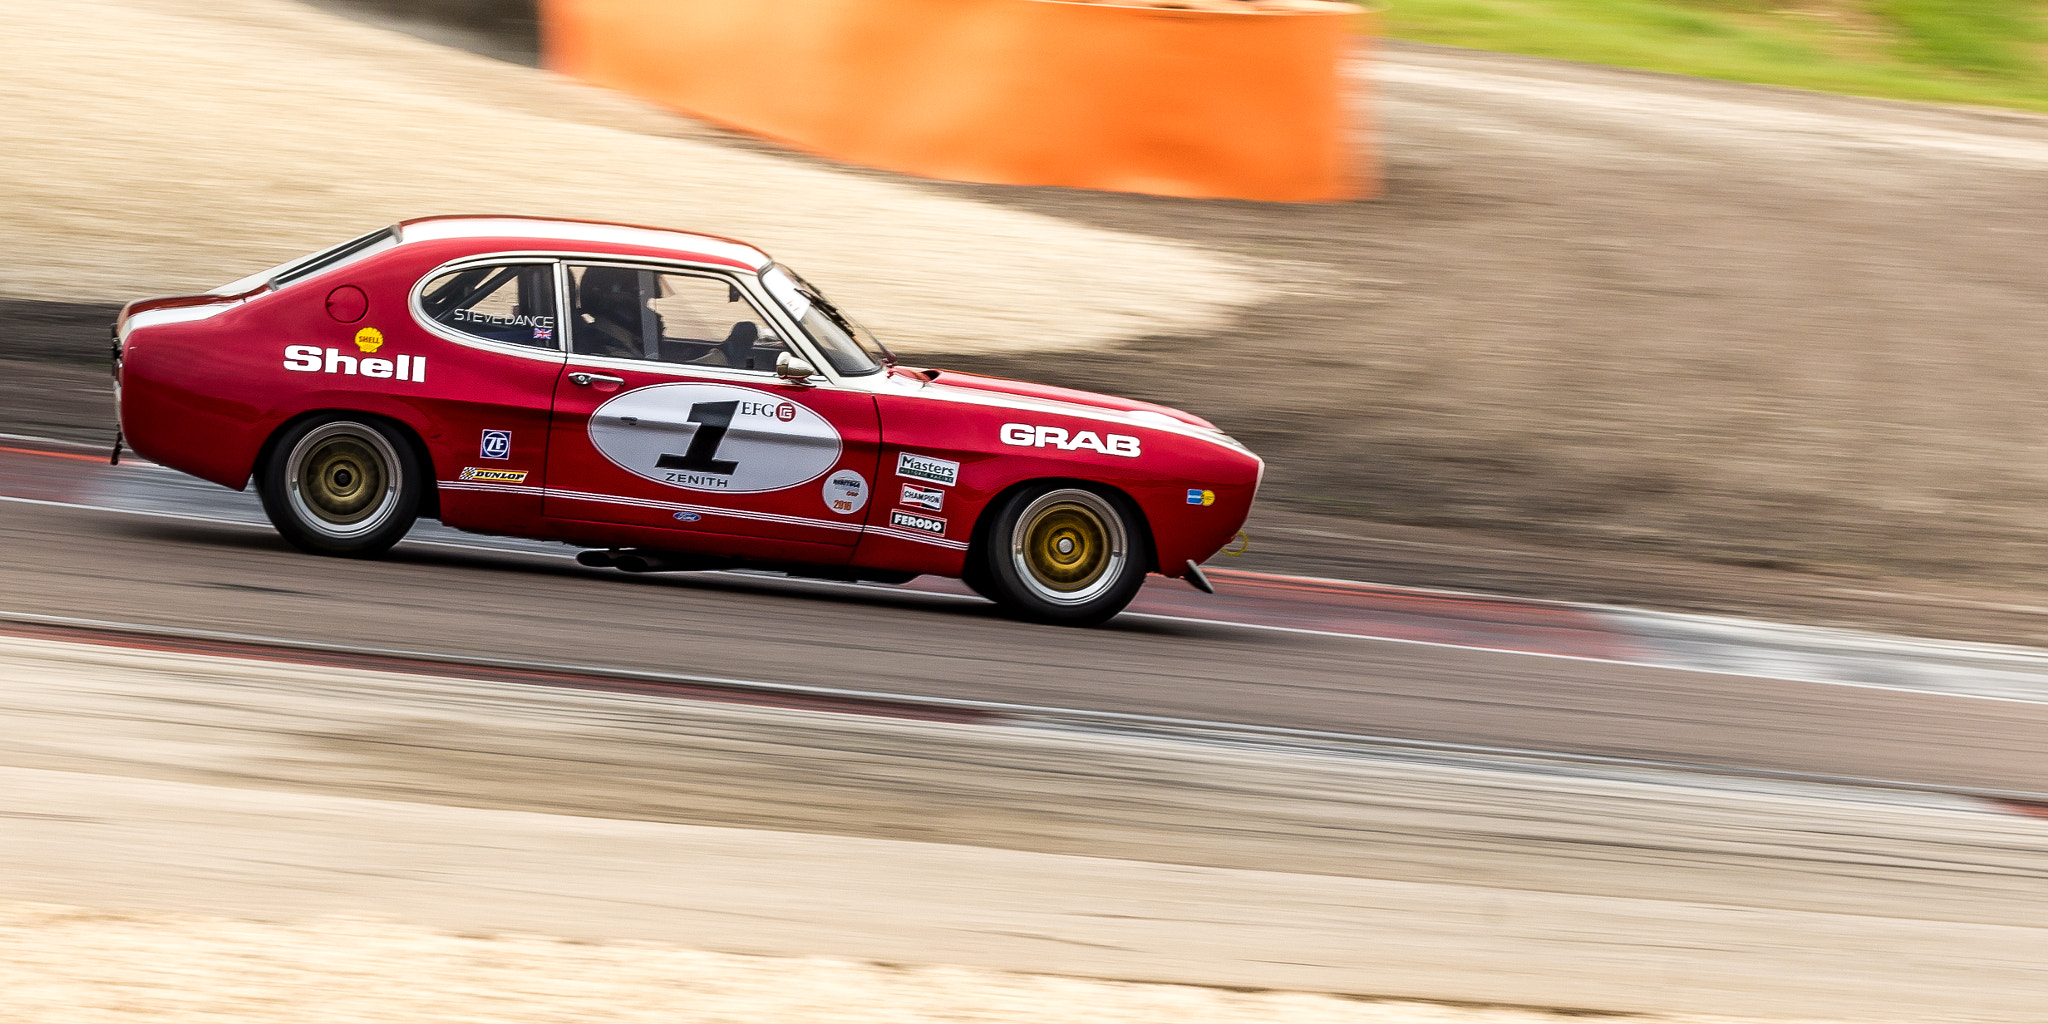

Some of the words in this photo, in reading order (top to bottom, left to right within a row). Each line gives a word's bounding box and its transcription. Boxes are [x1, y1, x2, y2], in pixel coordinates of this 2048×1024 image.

[454, 308, 502, 325] STEVE
[504, 313, 554, 329] DANCE
[358, 335, 380, 343] SHELL
[283, 344, 426, 383] Shell
[741, 401, 774, 417] EFG
[486, 436, 505, 452] ZF
[655, 400, 740, 476] 1
[1000, 422, 1141, 458] GRAB
[902, 455, 954, 477] Masters
[476, 470, 524, 480] DUNLOP
[665, 472, 728, 488] ZENITH
[904, 490, 940, 504] CHAMPION
[894, 513, 942, 532] FERODO
